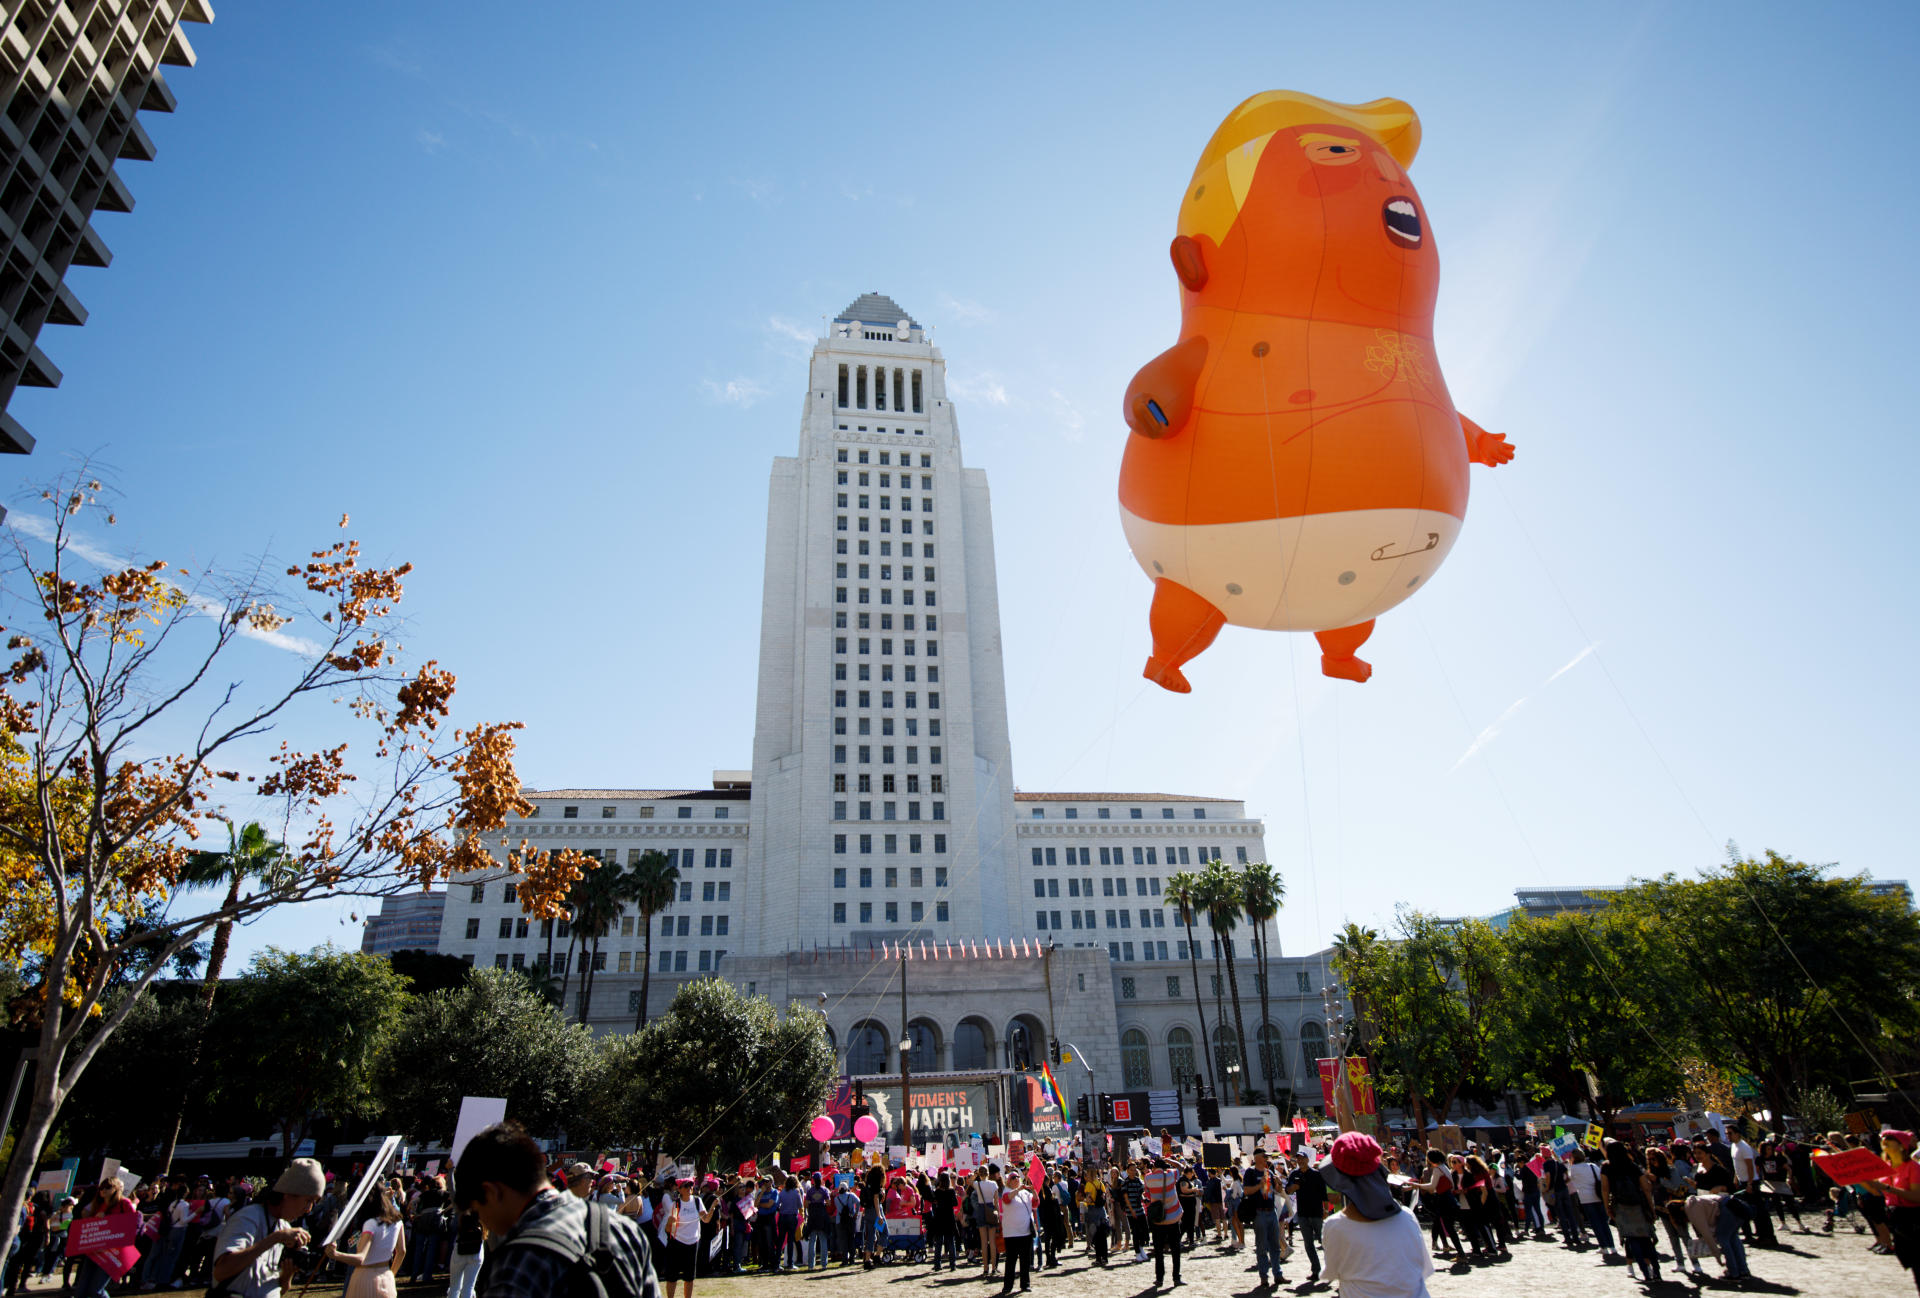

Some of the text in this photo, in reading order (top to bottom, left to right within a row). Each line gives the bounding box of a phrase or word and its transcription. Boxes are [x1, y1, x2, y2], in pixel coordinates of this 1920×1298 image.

[1673, 1111, 1703, 1125] NO ONE
[1032, 1122, 1062, 1132] MARCH
